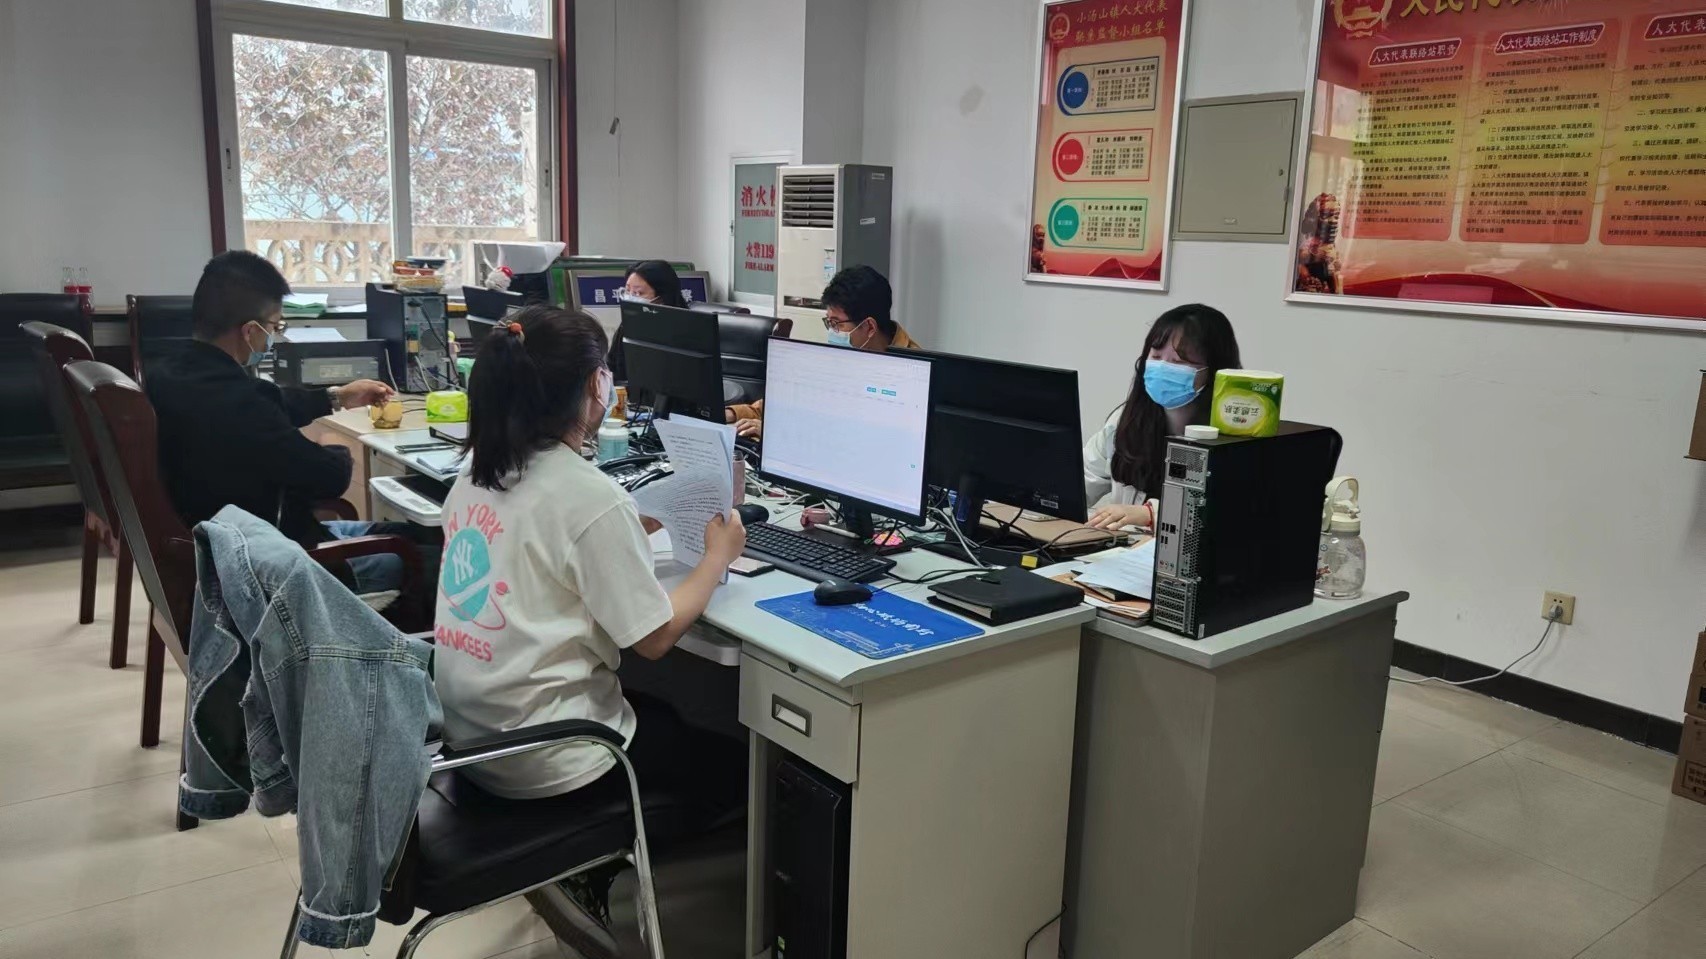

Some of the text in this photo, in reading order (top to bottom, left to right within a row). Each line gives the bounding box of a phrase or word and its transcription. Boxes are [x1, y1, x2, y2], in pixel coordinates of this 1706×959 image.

[1497, 28, 1598, 51] 人大代表联络站工作制度
[1372, 44, 1457, 64] 人大代表联络站职责
[746, 241, 775, 260] 火警119
[465, 503, 505, 545] YORK
[434, 623, 493, 663] ANKEES
